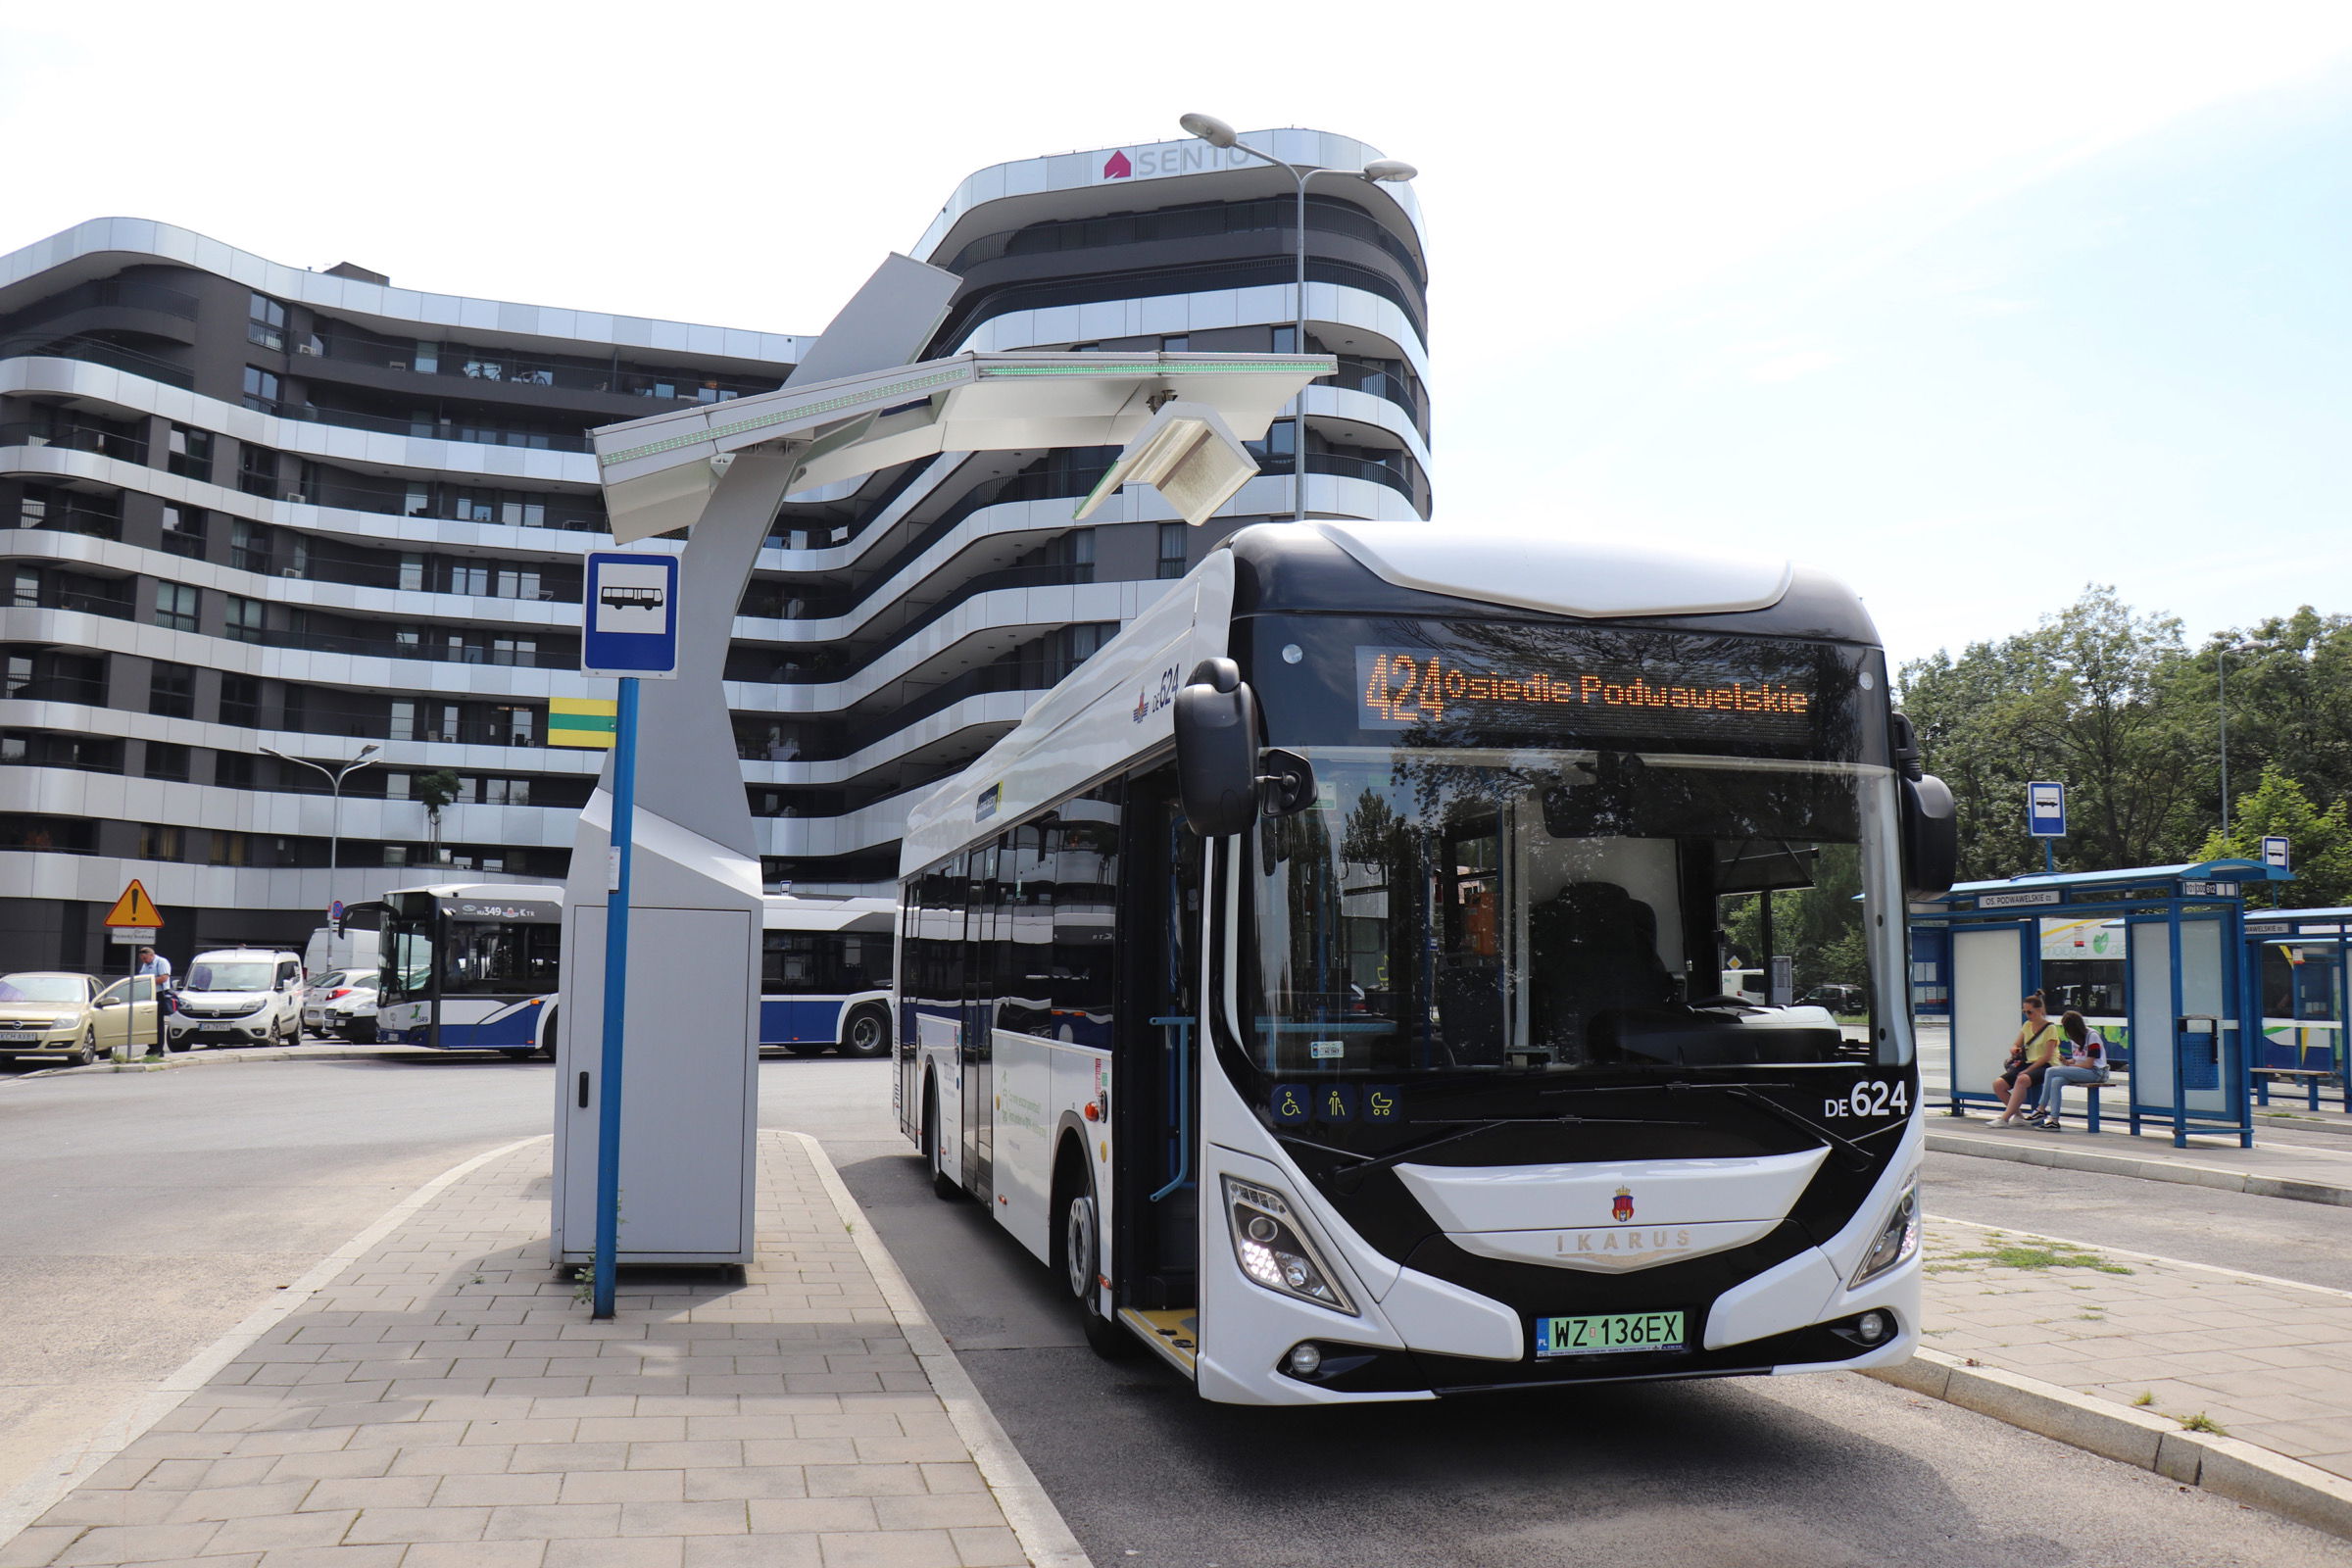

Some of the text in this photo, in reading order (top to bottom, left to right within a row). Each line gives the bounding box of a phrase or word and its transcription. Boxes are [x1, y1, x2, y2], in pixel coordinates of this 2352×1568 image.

[1139, 142, 1250, 176] SENTO
[1365, 654, 1809, 722] 424 Osiedle Podwawelskie
[1996, 894, 2044, 904] PODWAWELSKIE
[1557, 1229, 1690, 1252] IKARUS
[1555, 1319, 1588, 1348] WZ
[1600, 1314, 1678, 1346] 136EX
